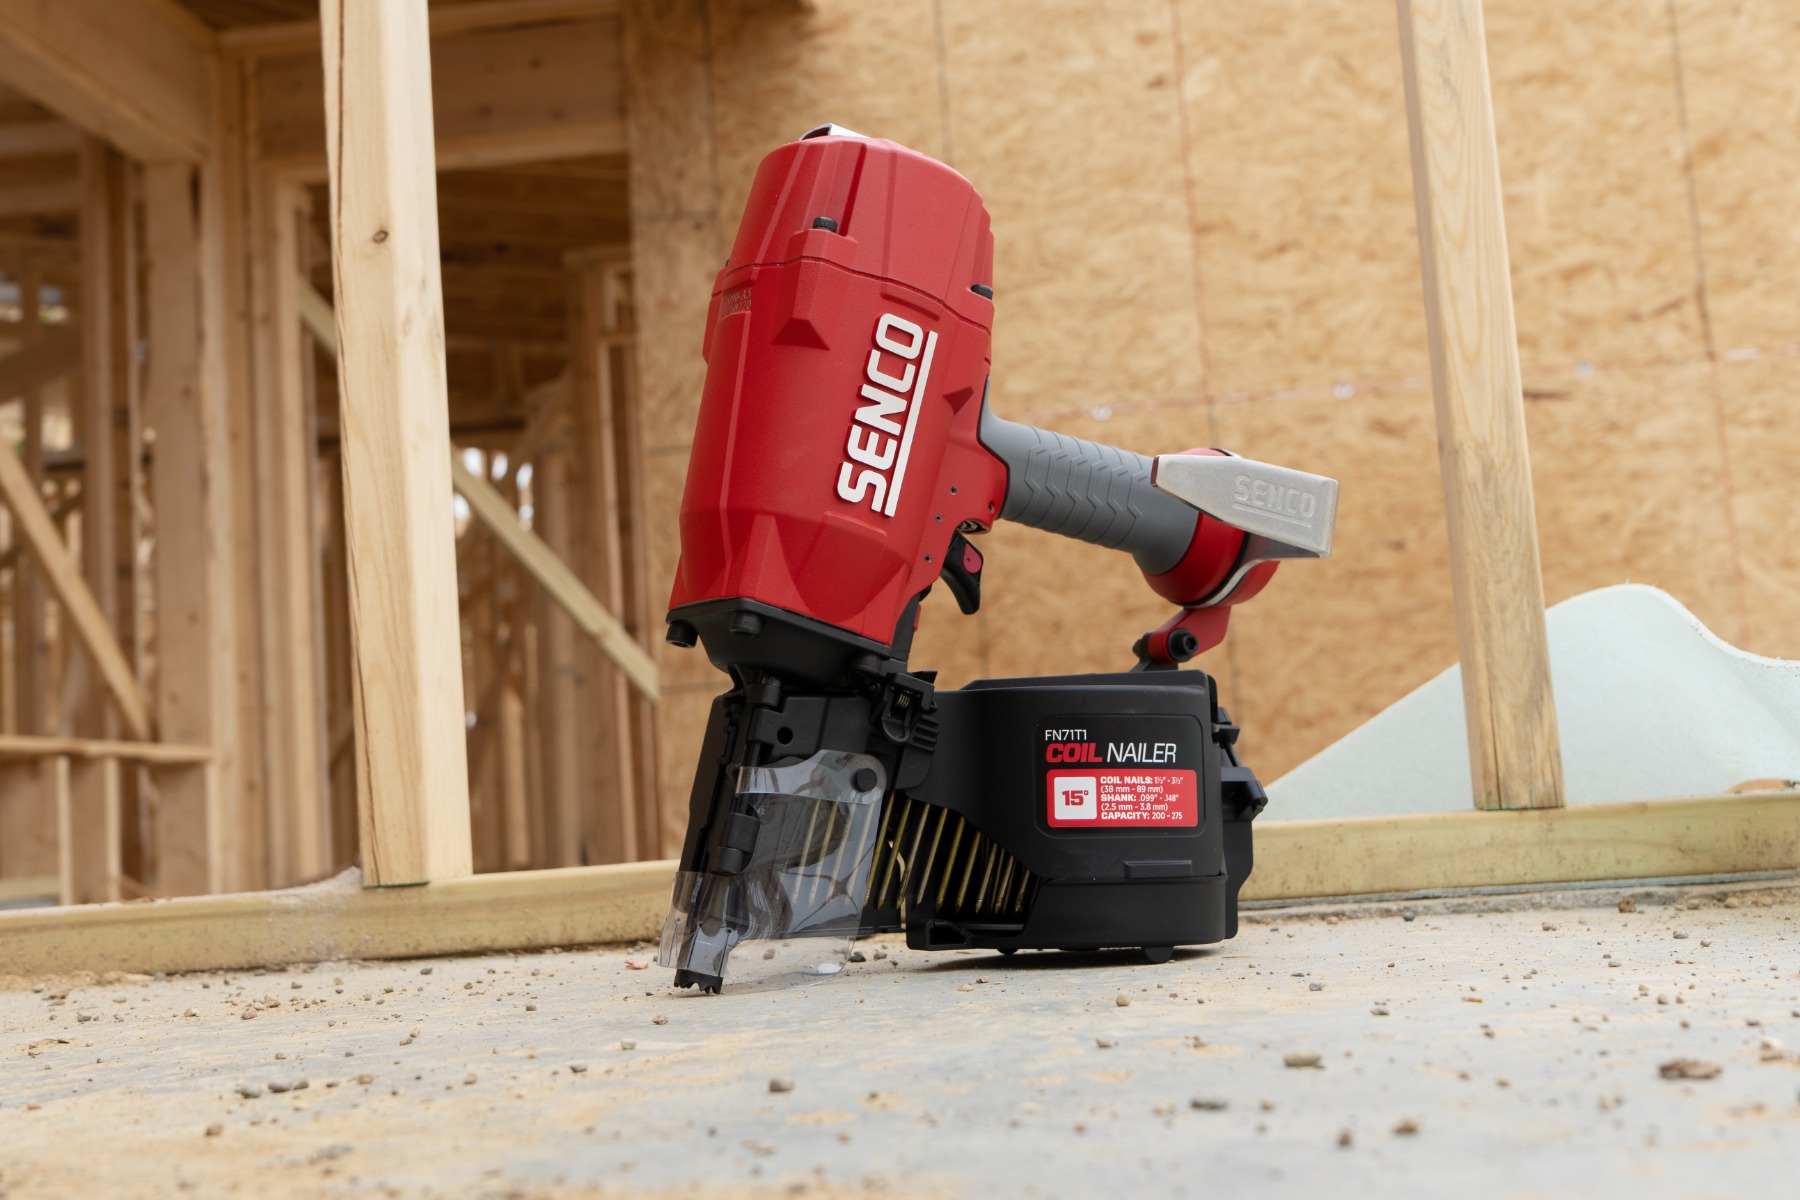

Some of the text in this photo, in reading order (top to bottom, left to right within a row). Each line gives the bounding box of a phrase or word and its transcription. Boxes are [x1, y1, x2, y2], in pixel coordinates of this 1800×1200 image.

[837, 313, 924, 512] SENCO
[1234, 474, 1315, 518] SENCO
[1045, 729, 1087, 741] FN71T1
[1045, 742, 1177, 763] COIL NAILER
[1100, 776, 1122, 784] COIL
[1124, 776, 1153, 784] NAILS:
[1100, 785, 1114, 793] (38
[1136, 785, 1146, 793] 89
[1147, 785, 1163, 794] mm)
[1062, 790, 1089, 806] 15°
[1100, 794, 1137, 802] SHANK:
[1101, 803, 1117, 812] (2.5
[1140, 803, 1151, 811] 3.8
[1152, 803, 1168, 812] mm)
[1101, 812, 1150, 820] CAPACITY:
[1151, 812, 1166, 820] 200
[1171, 812, 1183, 820] 275
